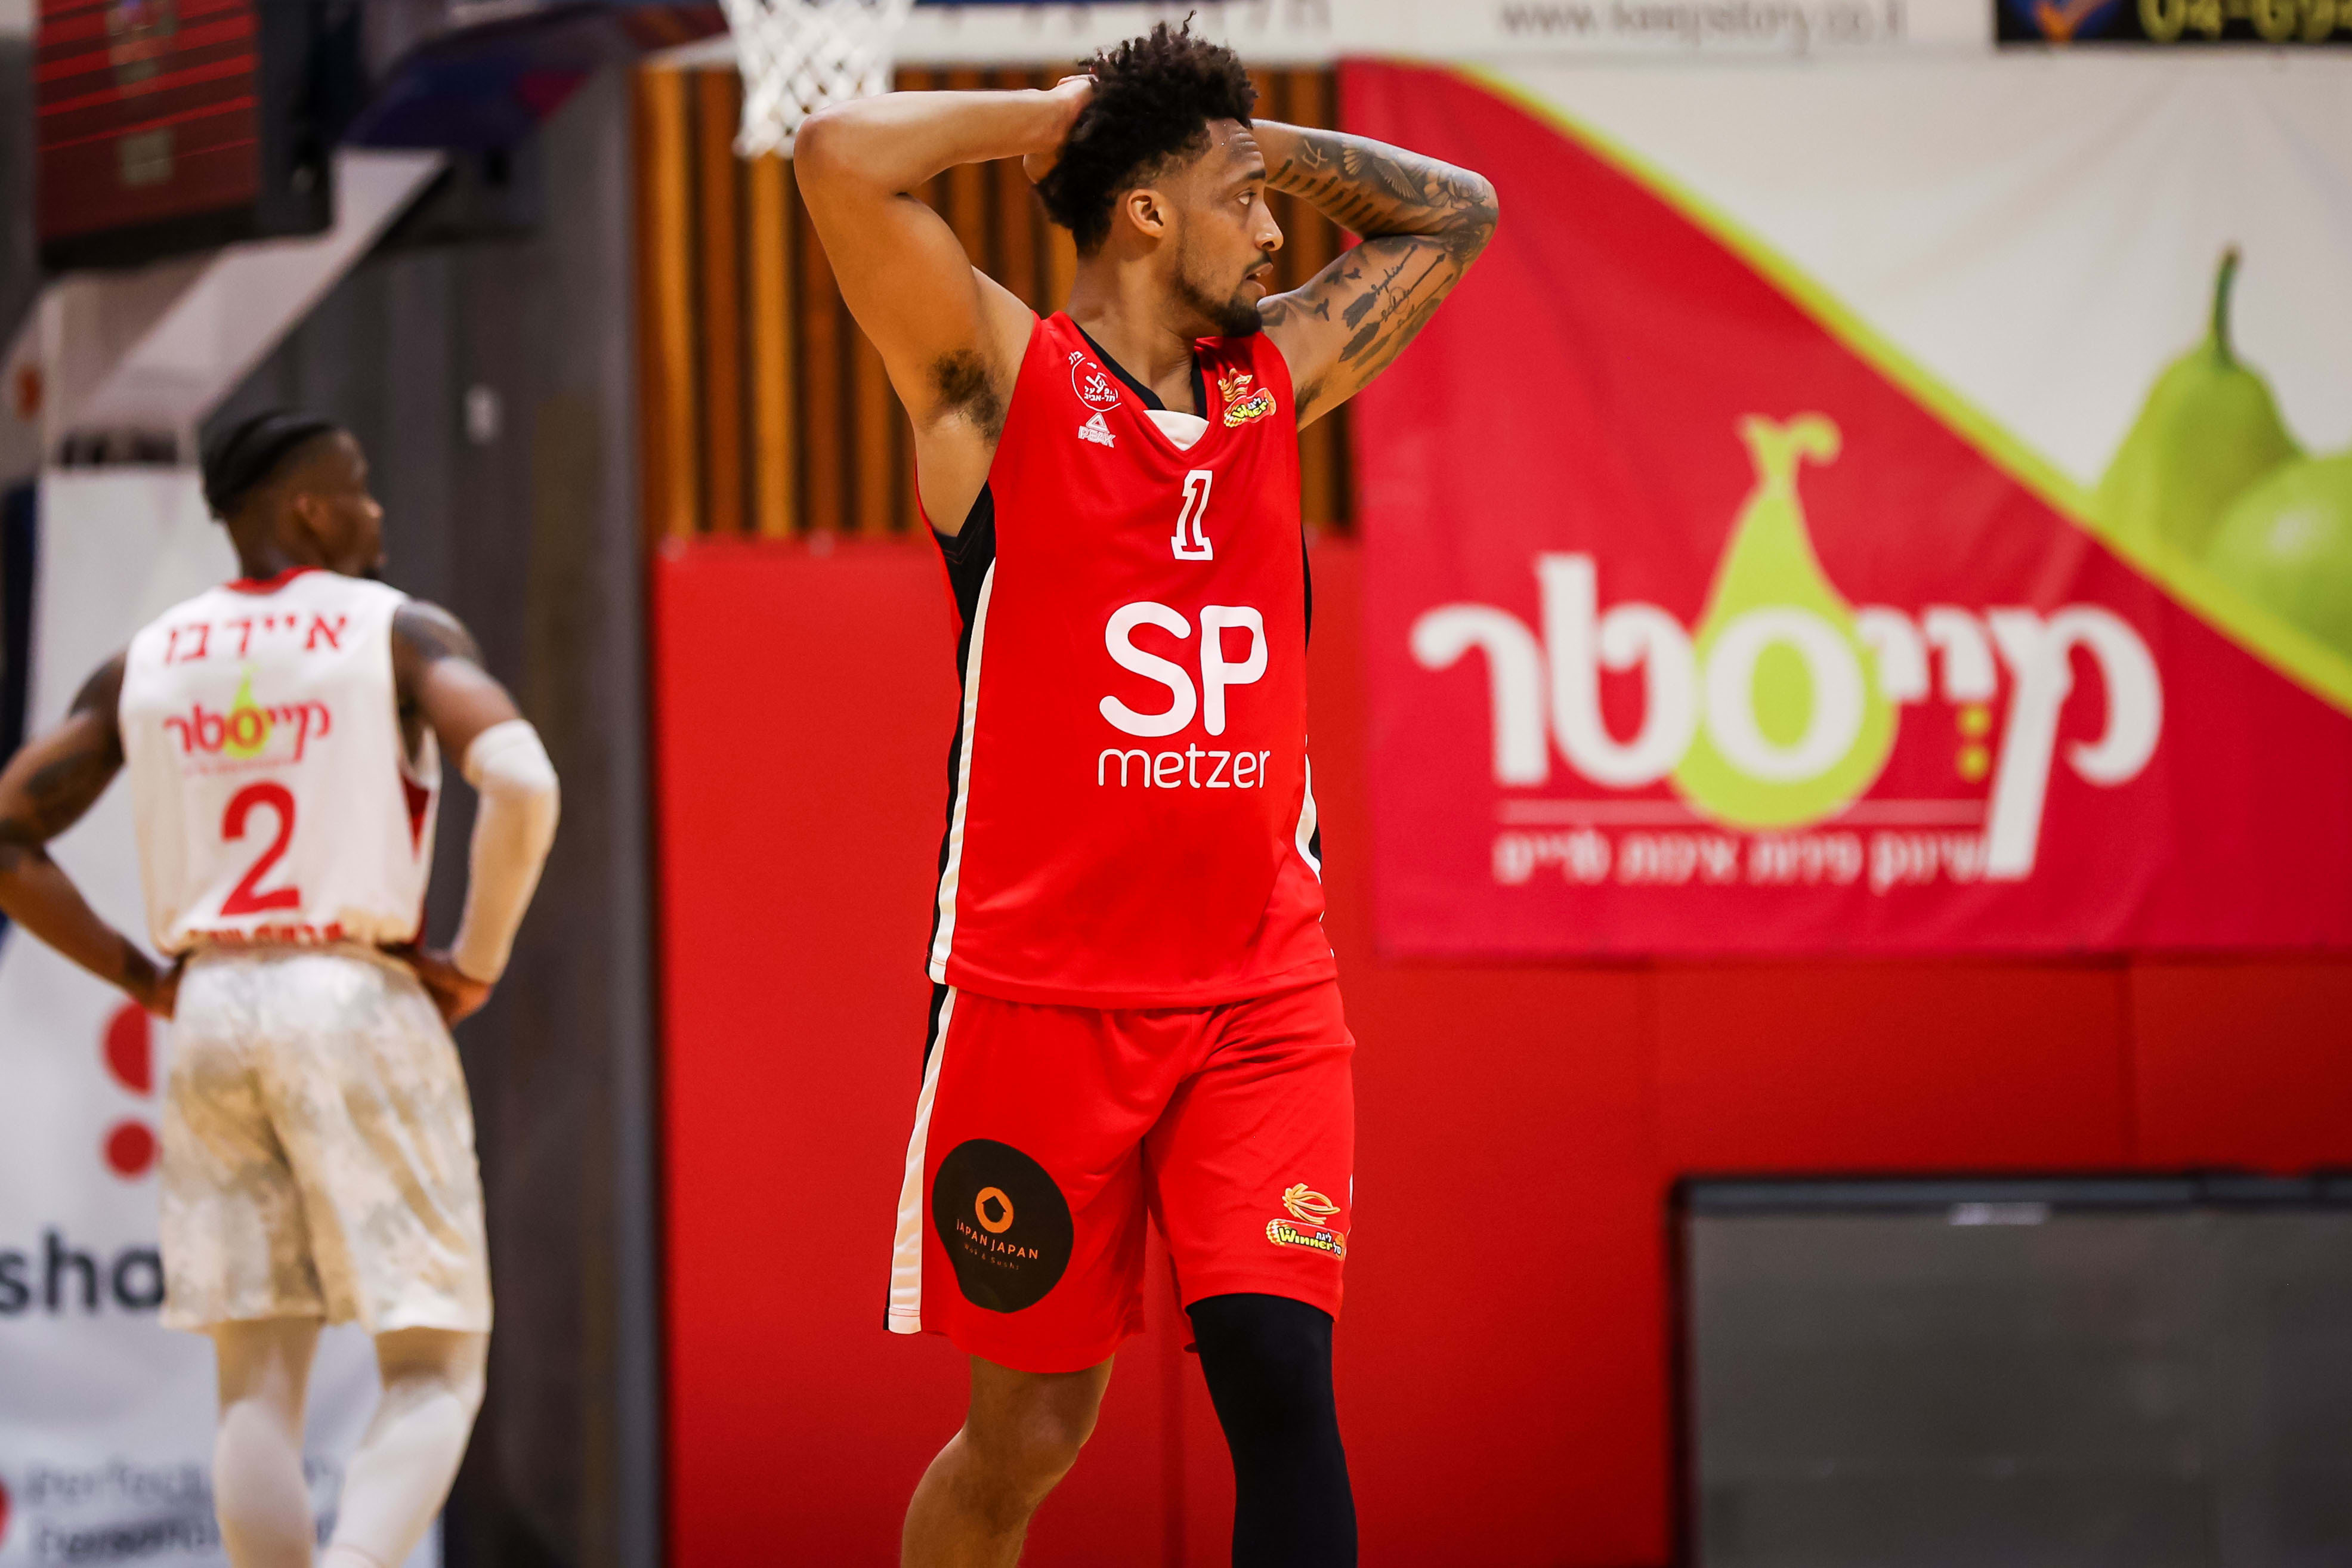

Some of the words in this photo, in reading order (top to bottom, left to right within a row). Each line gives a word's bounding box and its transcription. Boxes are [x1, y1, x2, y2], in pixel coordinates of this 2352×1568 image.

[1078, 425, 1115, 448] PEAK
[1171, 469, 1213, 561] 1
[1099, 601, 1269, 737] SP
[1098, 743, 1271, 788] metzer
[220, 781, 301, 918] 2
[956, 1218, 988, 1246] JAPAN
[990, 1239, 1039, 1260] JAPAN
[1278, 1227, 1333, 1251] Winner
